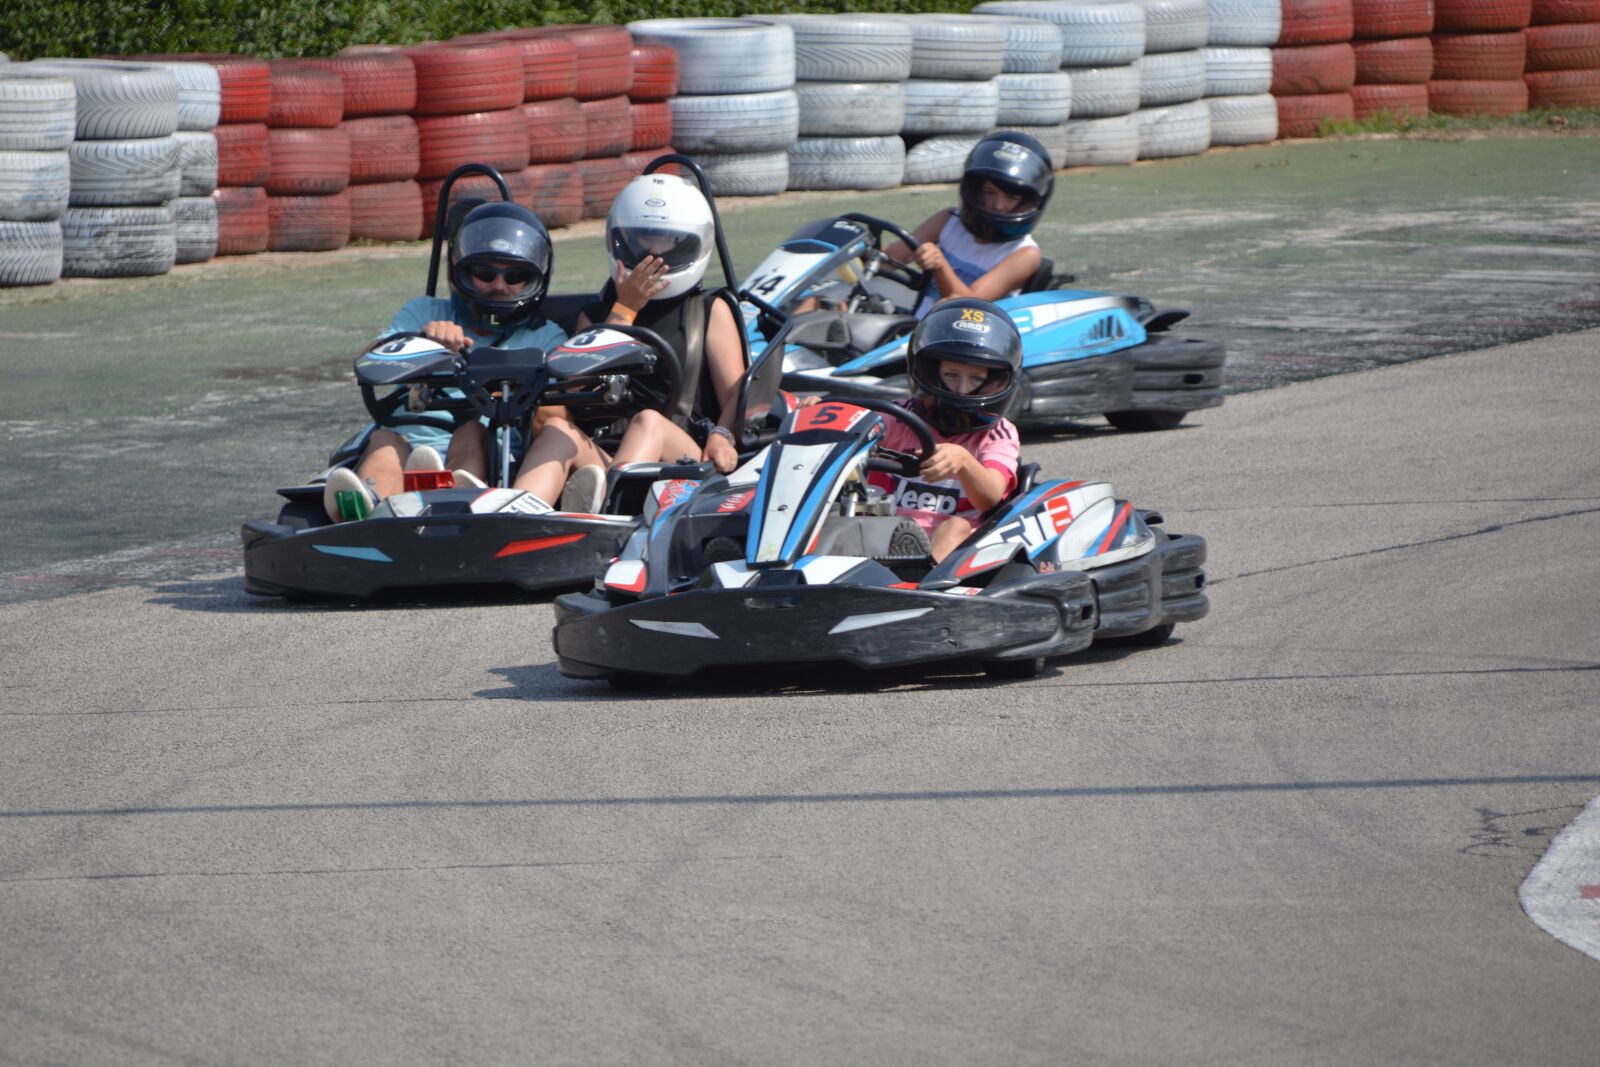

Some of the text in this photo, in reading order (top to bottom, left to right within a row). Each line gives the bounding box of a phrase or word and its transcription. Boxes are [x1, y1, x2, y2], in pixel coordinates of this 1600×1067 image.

[747, 273, 786, 296] 14
[961, 308, 985, 323] XS
[809, 405, 844, 425] 5
